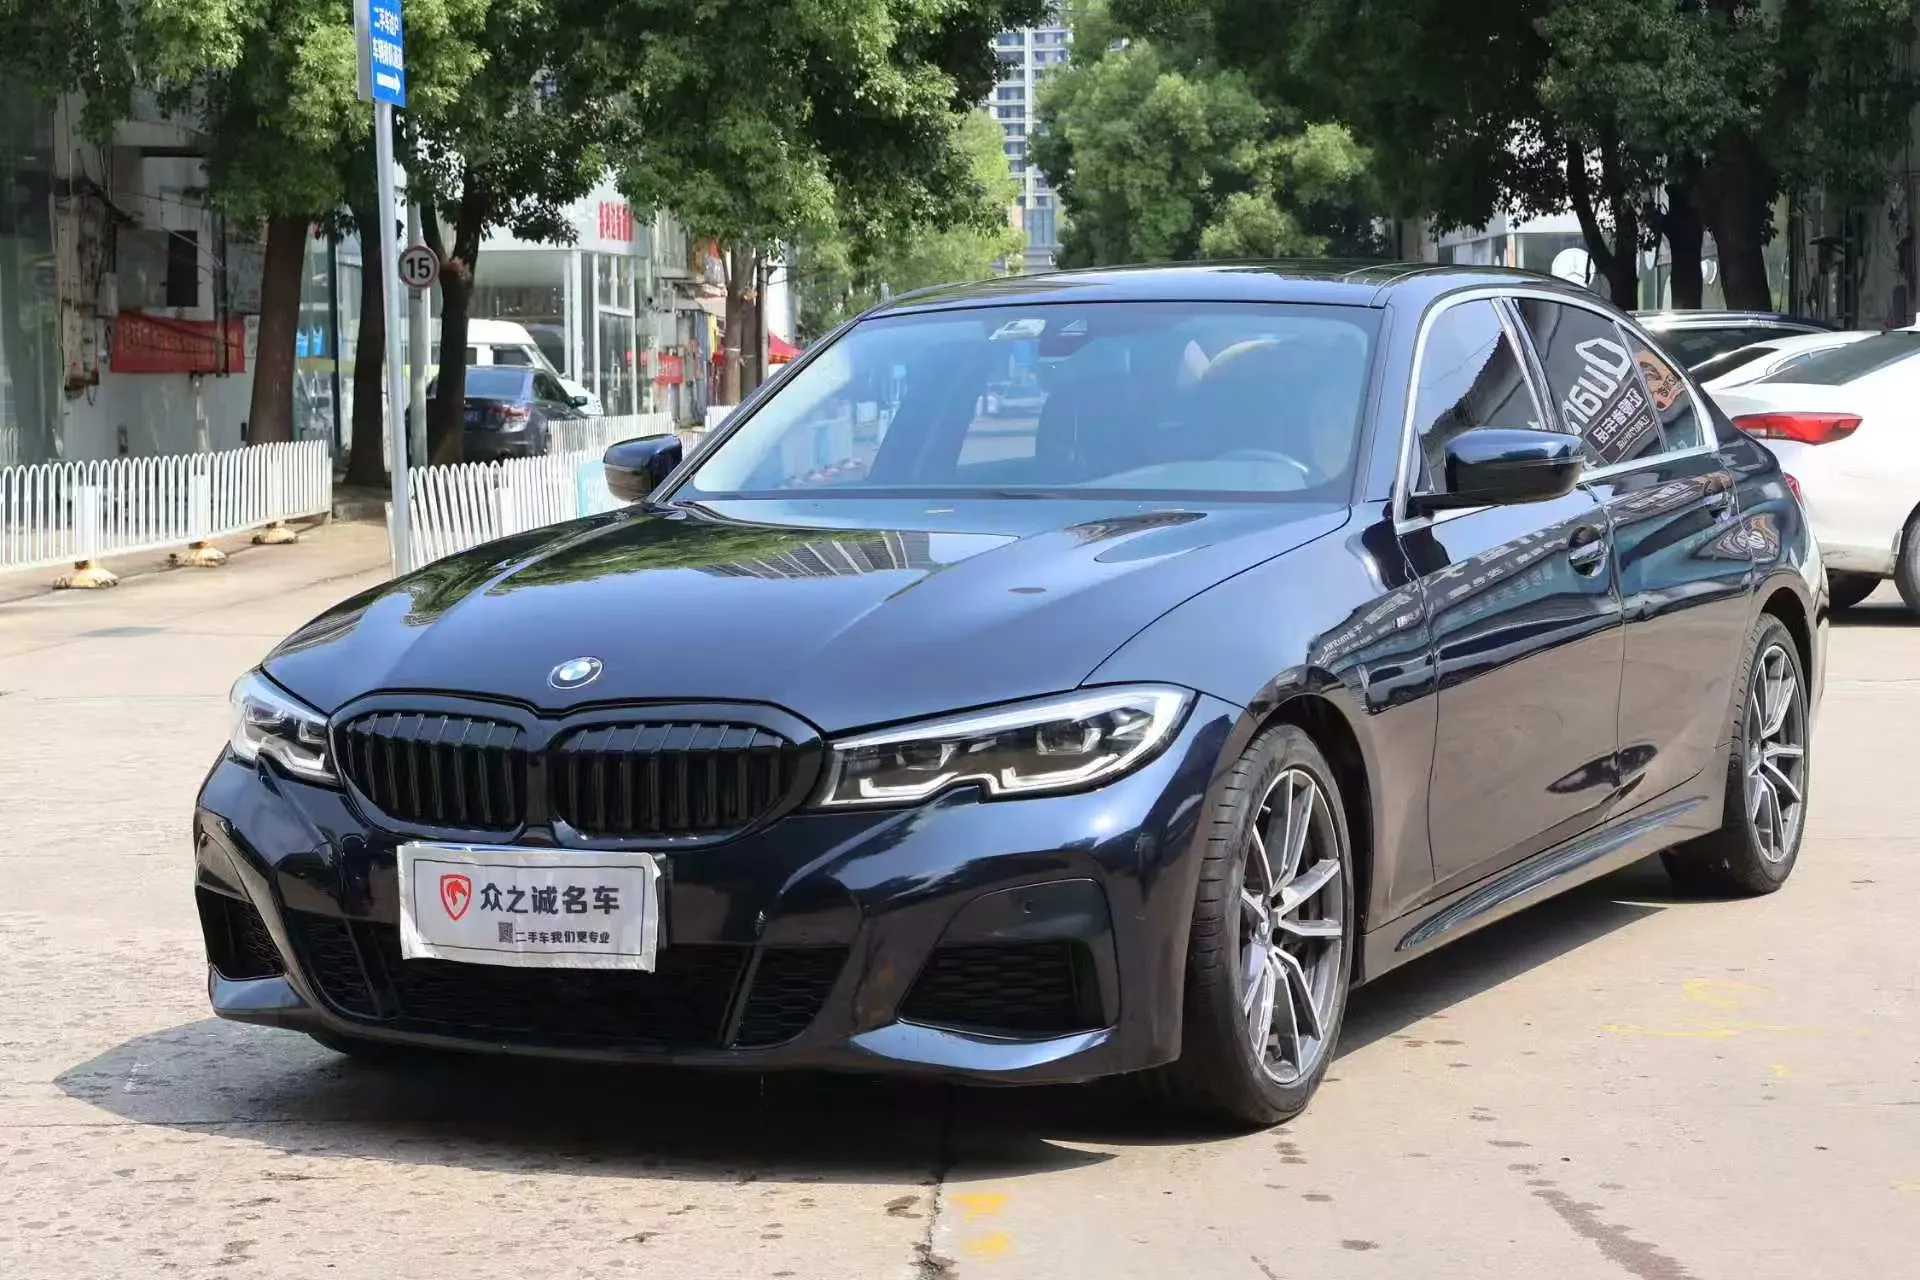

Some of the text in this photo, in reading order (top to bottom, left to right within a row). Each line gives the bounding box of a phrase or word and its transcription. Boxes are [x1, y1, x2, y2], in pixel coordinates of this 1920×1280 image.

[406, 257, 431, 279] 15
[480, 882, 620, 915] 众之诚名车
[515, 930, 610, 944] 二手车我们更专业
